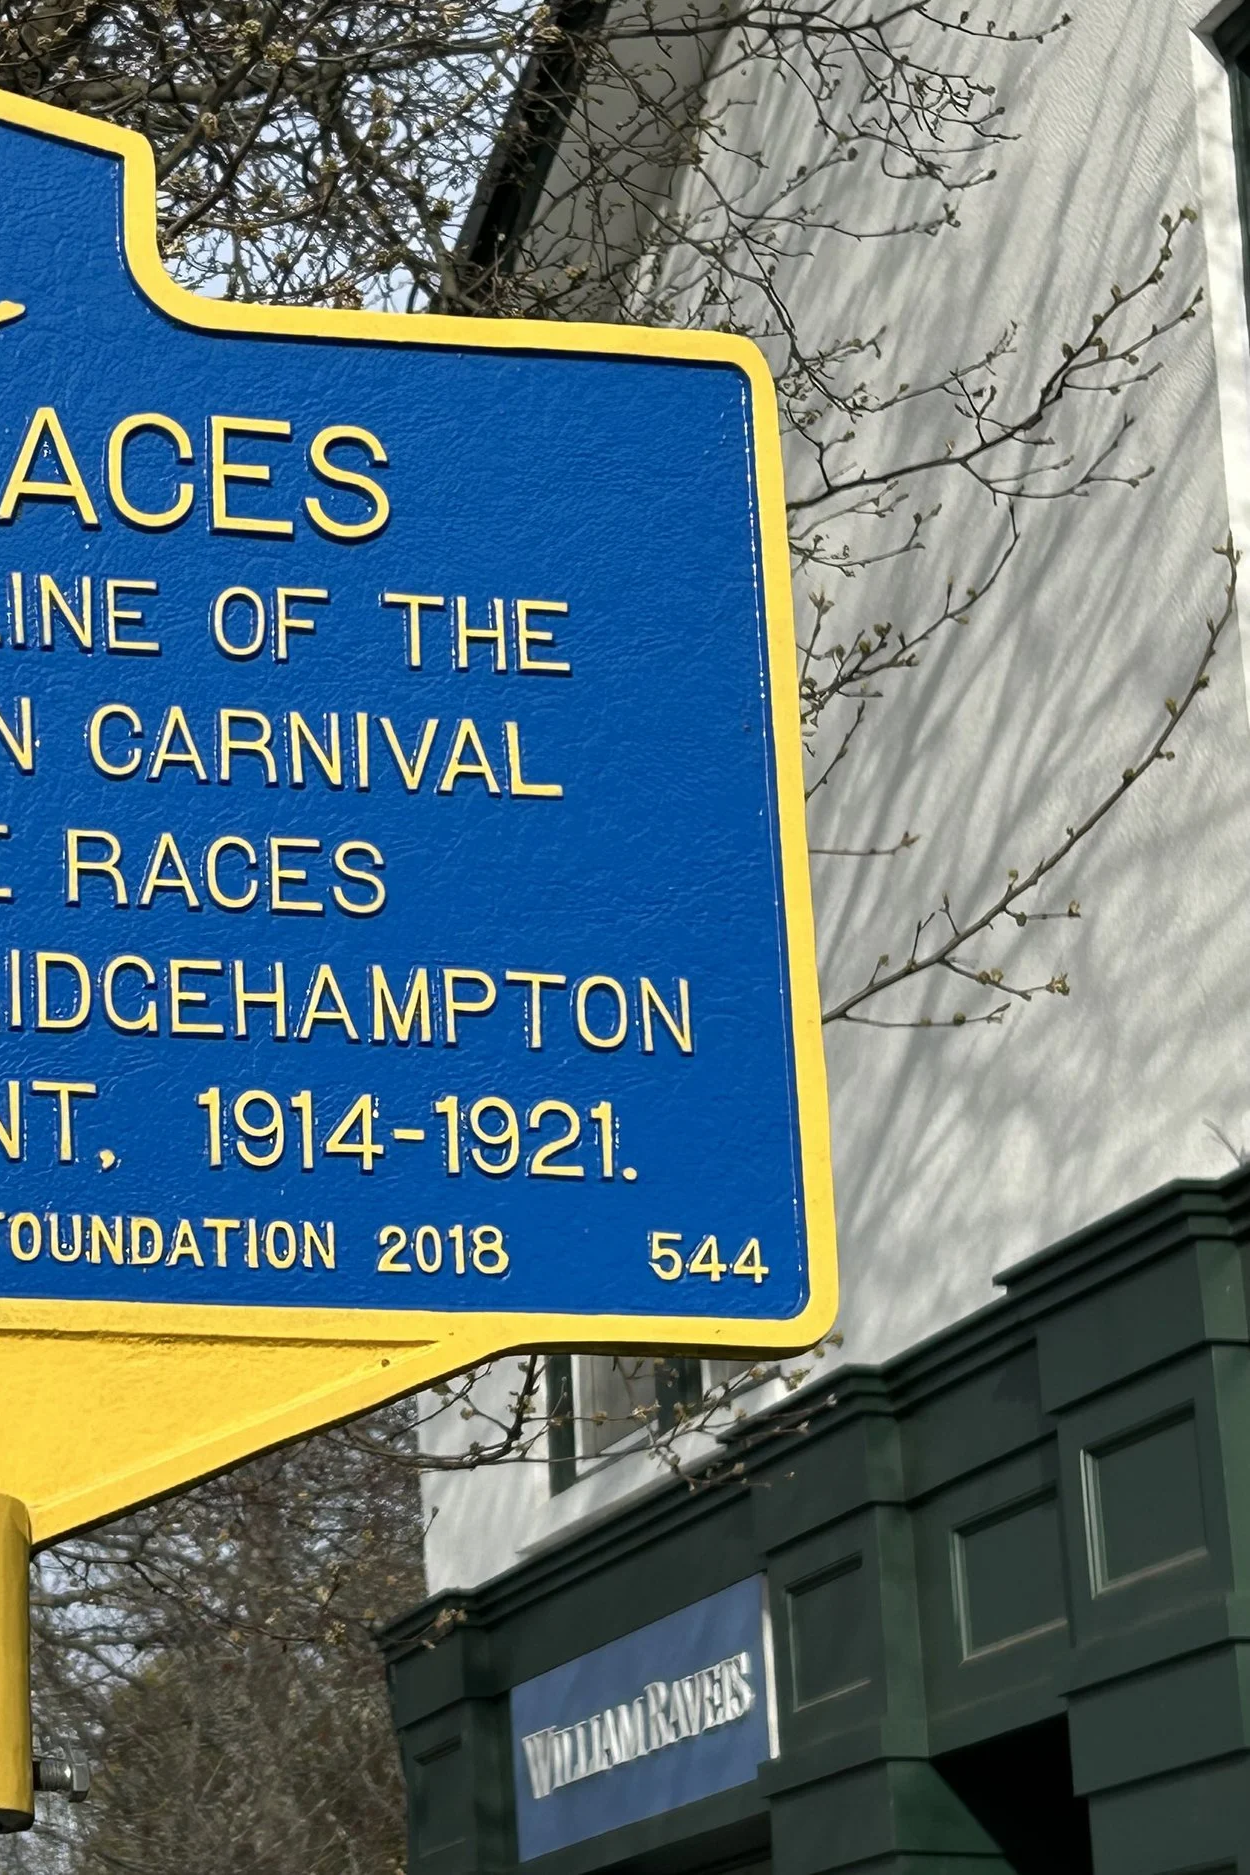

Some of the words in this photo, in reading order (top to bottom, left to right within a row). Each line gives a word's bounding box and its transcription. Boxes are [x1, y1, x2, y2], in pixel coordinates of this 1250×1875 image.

[214, 585, 328, 659] OF
[383, 592, 570, 671] THE
[89, 703, 563, 797] CARNIVAL
[66, 828, 386, 914] RACES
[198, 1086, 638, 1181] 1914-1921.
[377, 1224, 510, 1275] 2018
[651, 1231, 770, 1284] 544
[522, 1695, 647, 1799] WILLIAM
